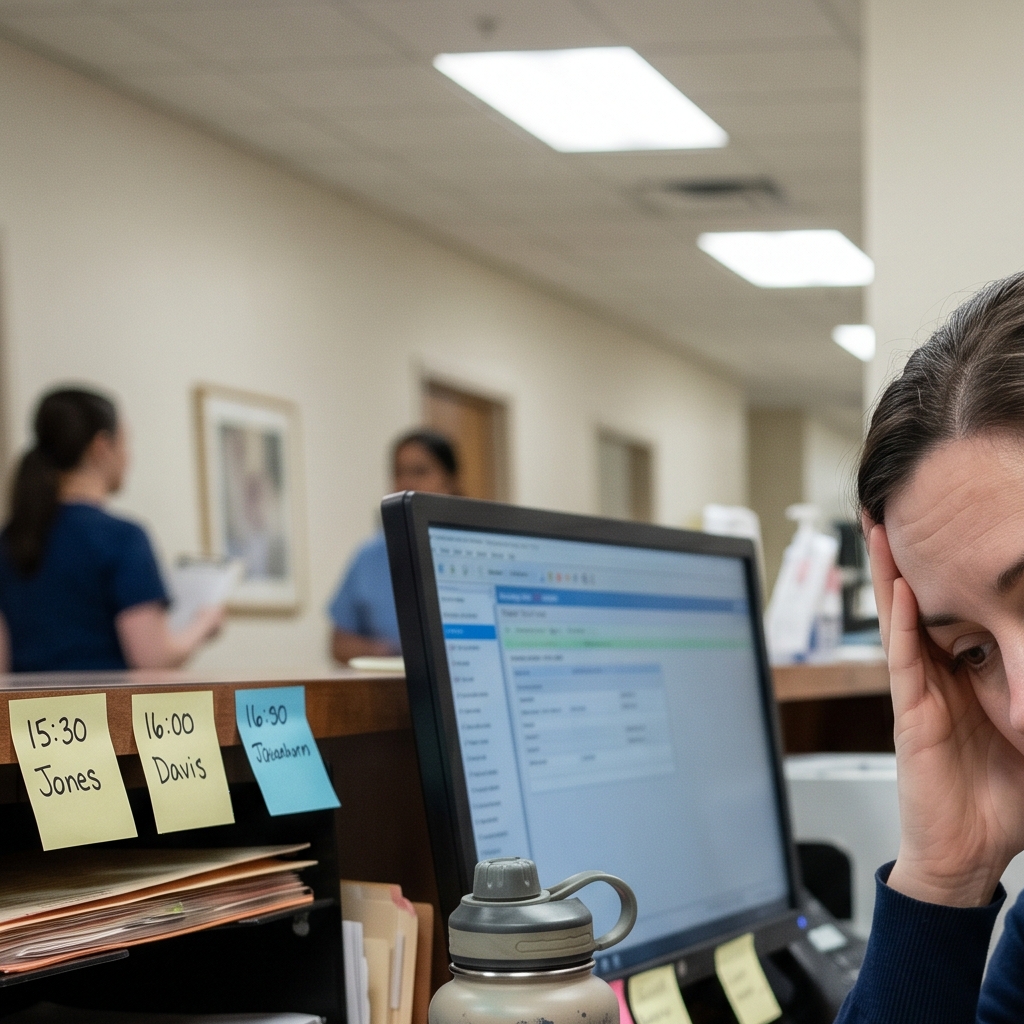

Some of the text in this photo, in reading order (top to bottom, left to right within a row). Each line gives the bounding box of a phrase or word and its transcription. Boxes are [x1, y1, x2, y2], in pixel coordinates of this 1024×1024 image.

[27, 717, 87, 749] 15:30
[145, 712, 195, 740] 16:00
[34, 764, 102, 798] Jones
[152, 756, 207, 784] Davis
